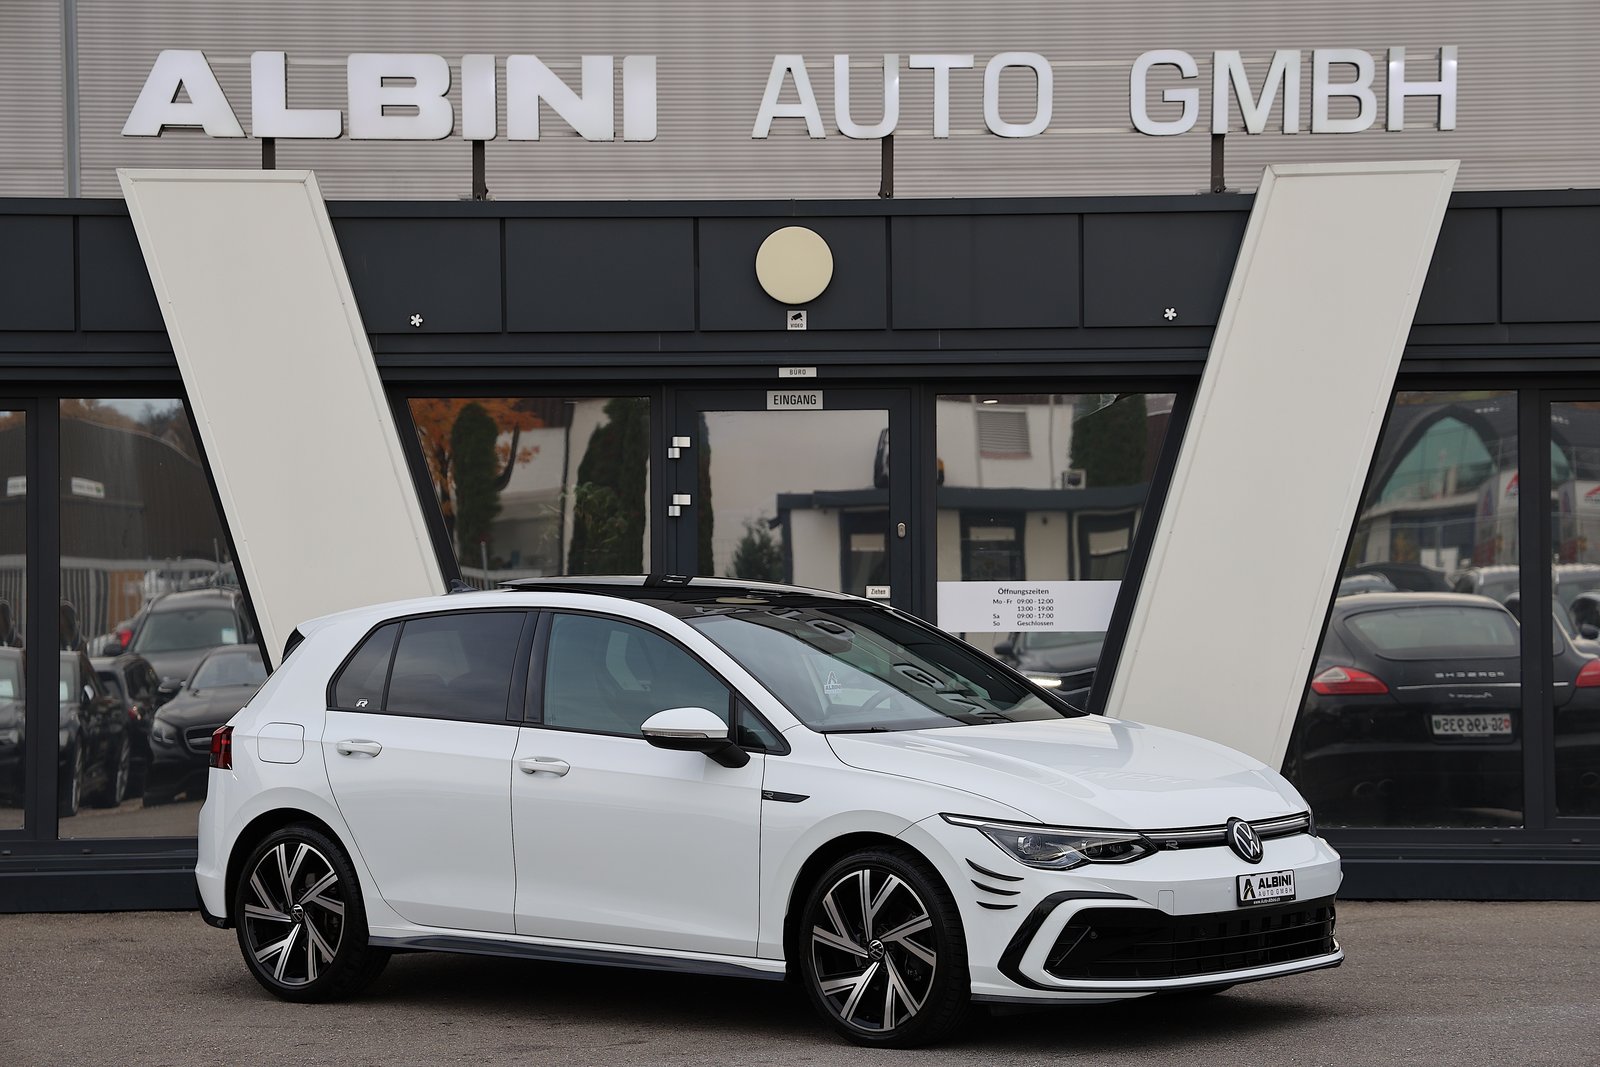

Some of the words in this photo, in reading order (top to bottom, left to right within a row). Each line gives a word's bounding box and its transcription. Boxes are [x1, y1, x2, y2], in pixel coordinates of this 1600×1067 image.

[121, 50, 657, 141] ALBINI
[752, 52, 1054, 139] AUTO
[1130, 45, 1458, 136] GMBH
[789, 367, 807, 376] BÜRO
[773, 394, 817, 405] EINGANG
[998, 587, 1049, 596] Öffnungszeiten
[1258, 874, 1292, 889] ALBINI
[1258, 889, 1274, 897] AUTO
[1275, 886, 1292, 896] GMBH
